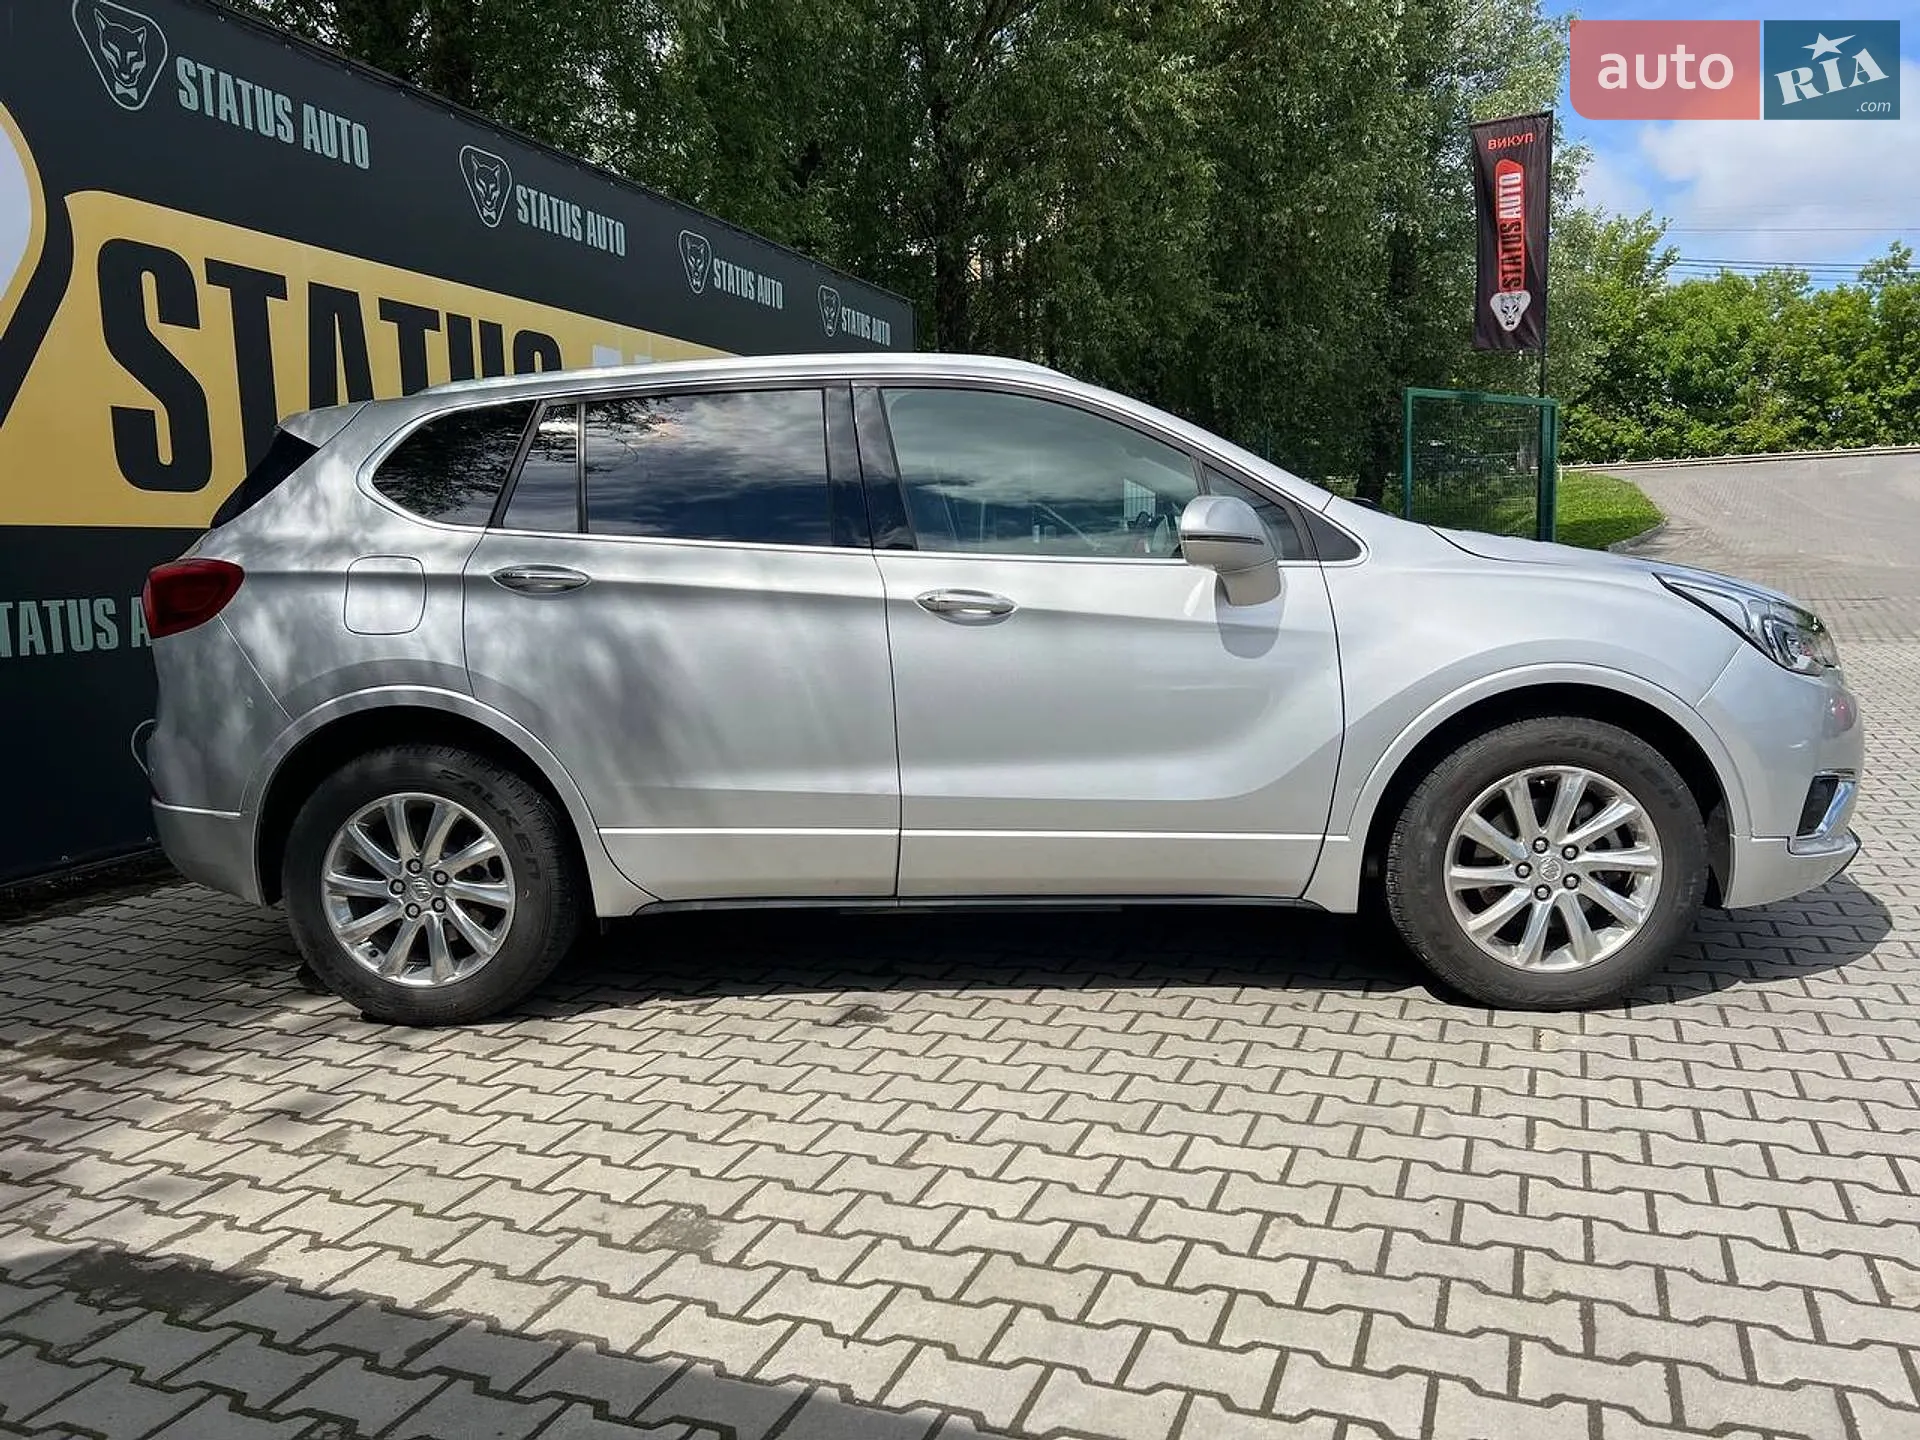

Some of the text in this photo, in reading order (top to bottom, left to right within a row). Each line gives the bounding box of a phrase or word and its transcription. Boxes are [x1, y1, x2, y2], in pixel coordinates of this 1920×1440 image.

[175, 56, 369, 169] STATUS AUTO
[1487, 132, 1535, 150] ВИКУП
[516, 184, 625, 257] STATUS AUTO
[1499, 172, 1523, 288] STATUS AUTO
[713, 258, 783, 309] STATUS AUTO
[841, 306, 891, 346] STATUS AUTO
[97, 238, 562, 493] STAT
[0, 598, 118, 657] TATUS
